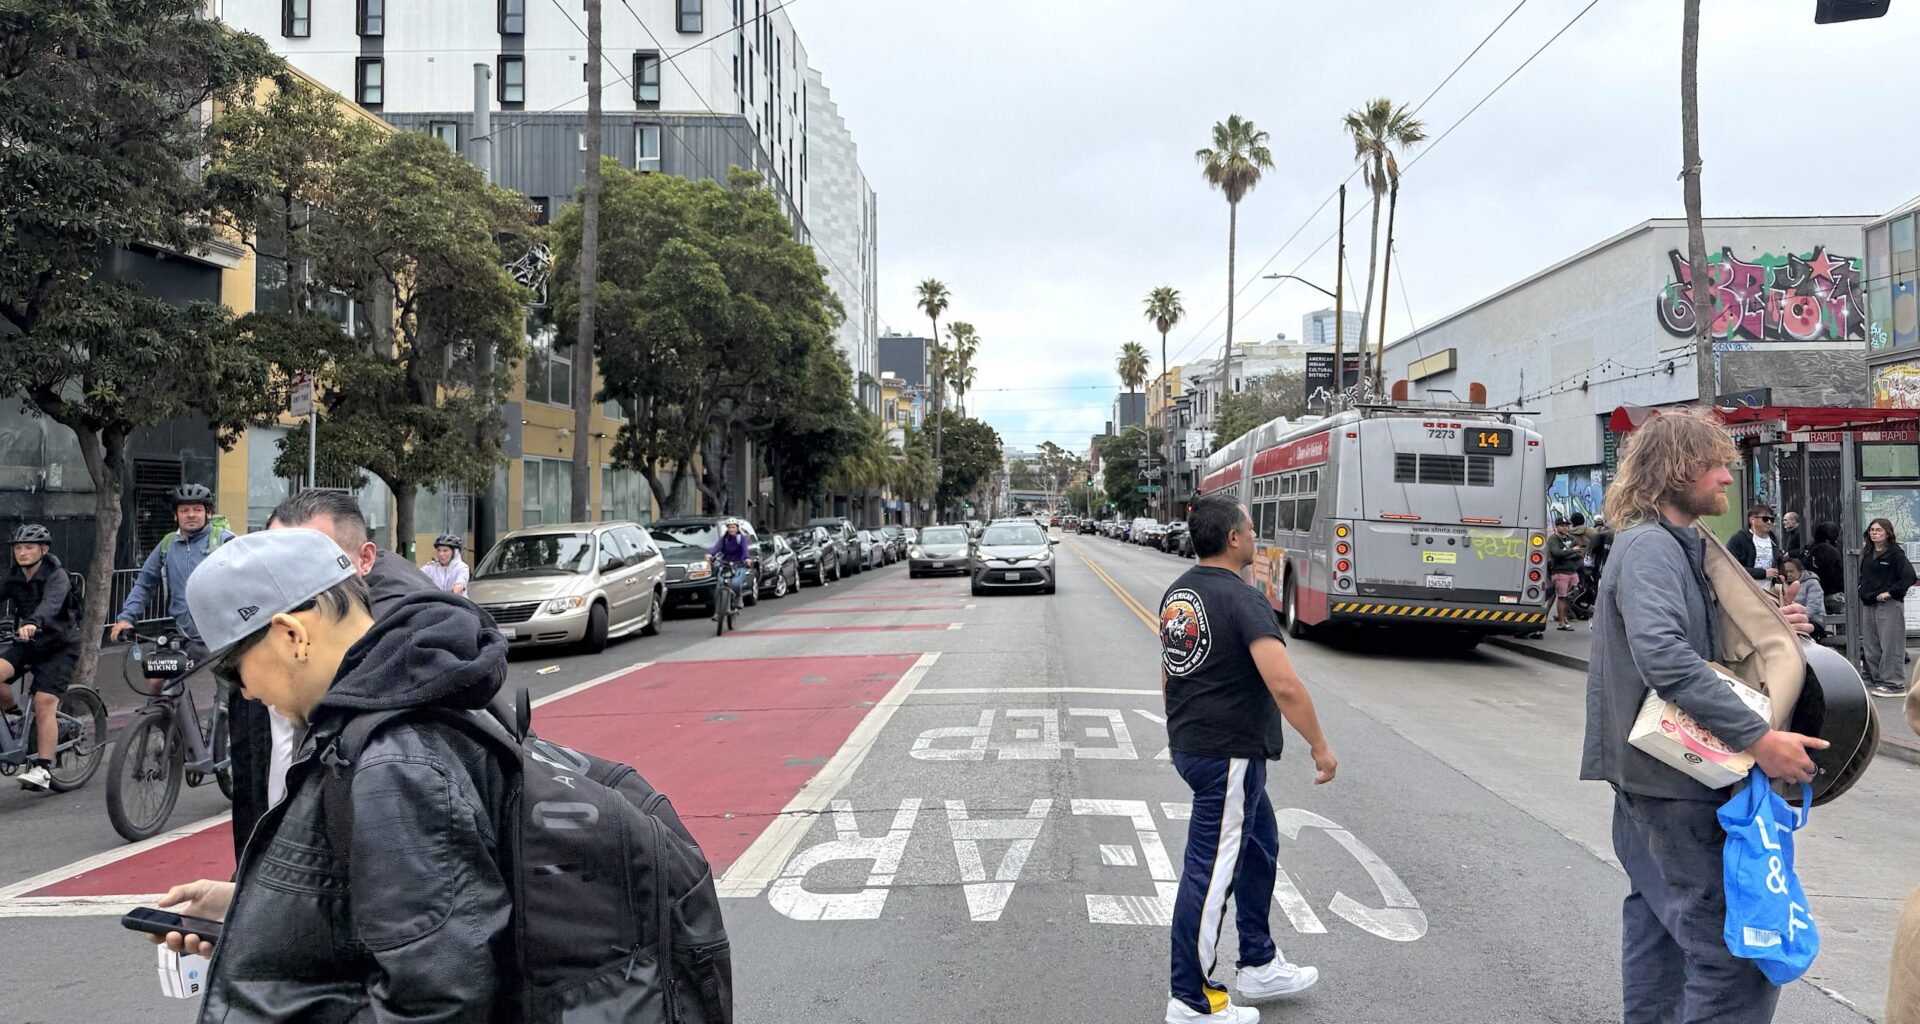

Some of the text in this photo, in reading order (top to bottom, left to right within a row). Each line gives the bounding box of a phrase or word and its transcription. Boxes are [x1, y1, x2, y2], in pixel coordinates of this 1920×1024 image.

[1428, 429, 1455, 439] 7273
[1811, 431, 1837, 442] RAPID
[1882, 431, 1908, 441] RAPID
[1478, 432, 1500, 448] 14
[1412, 526, 1468, 534] www.sfmta.com
